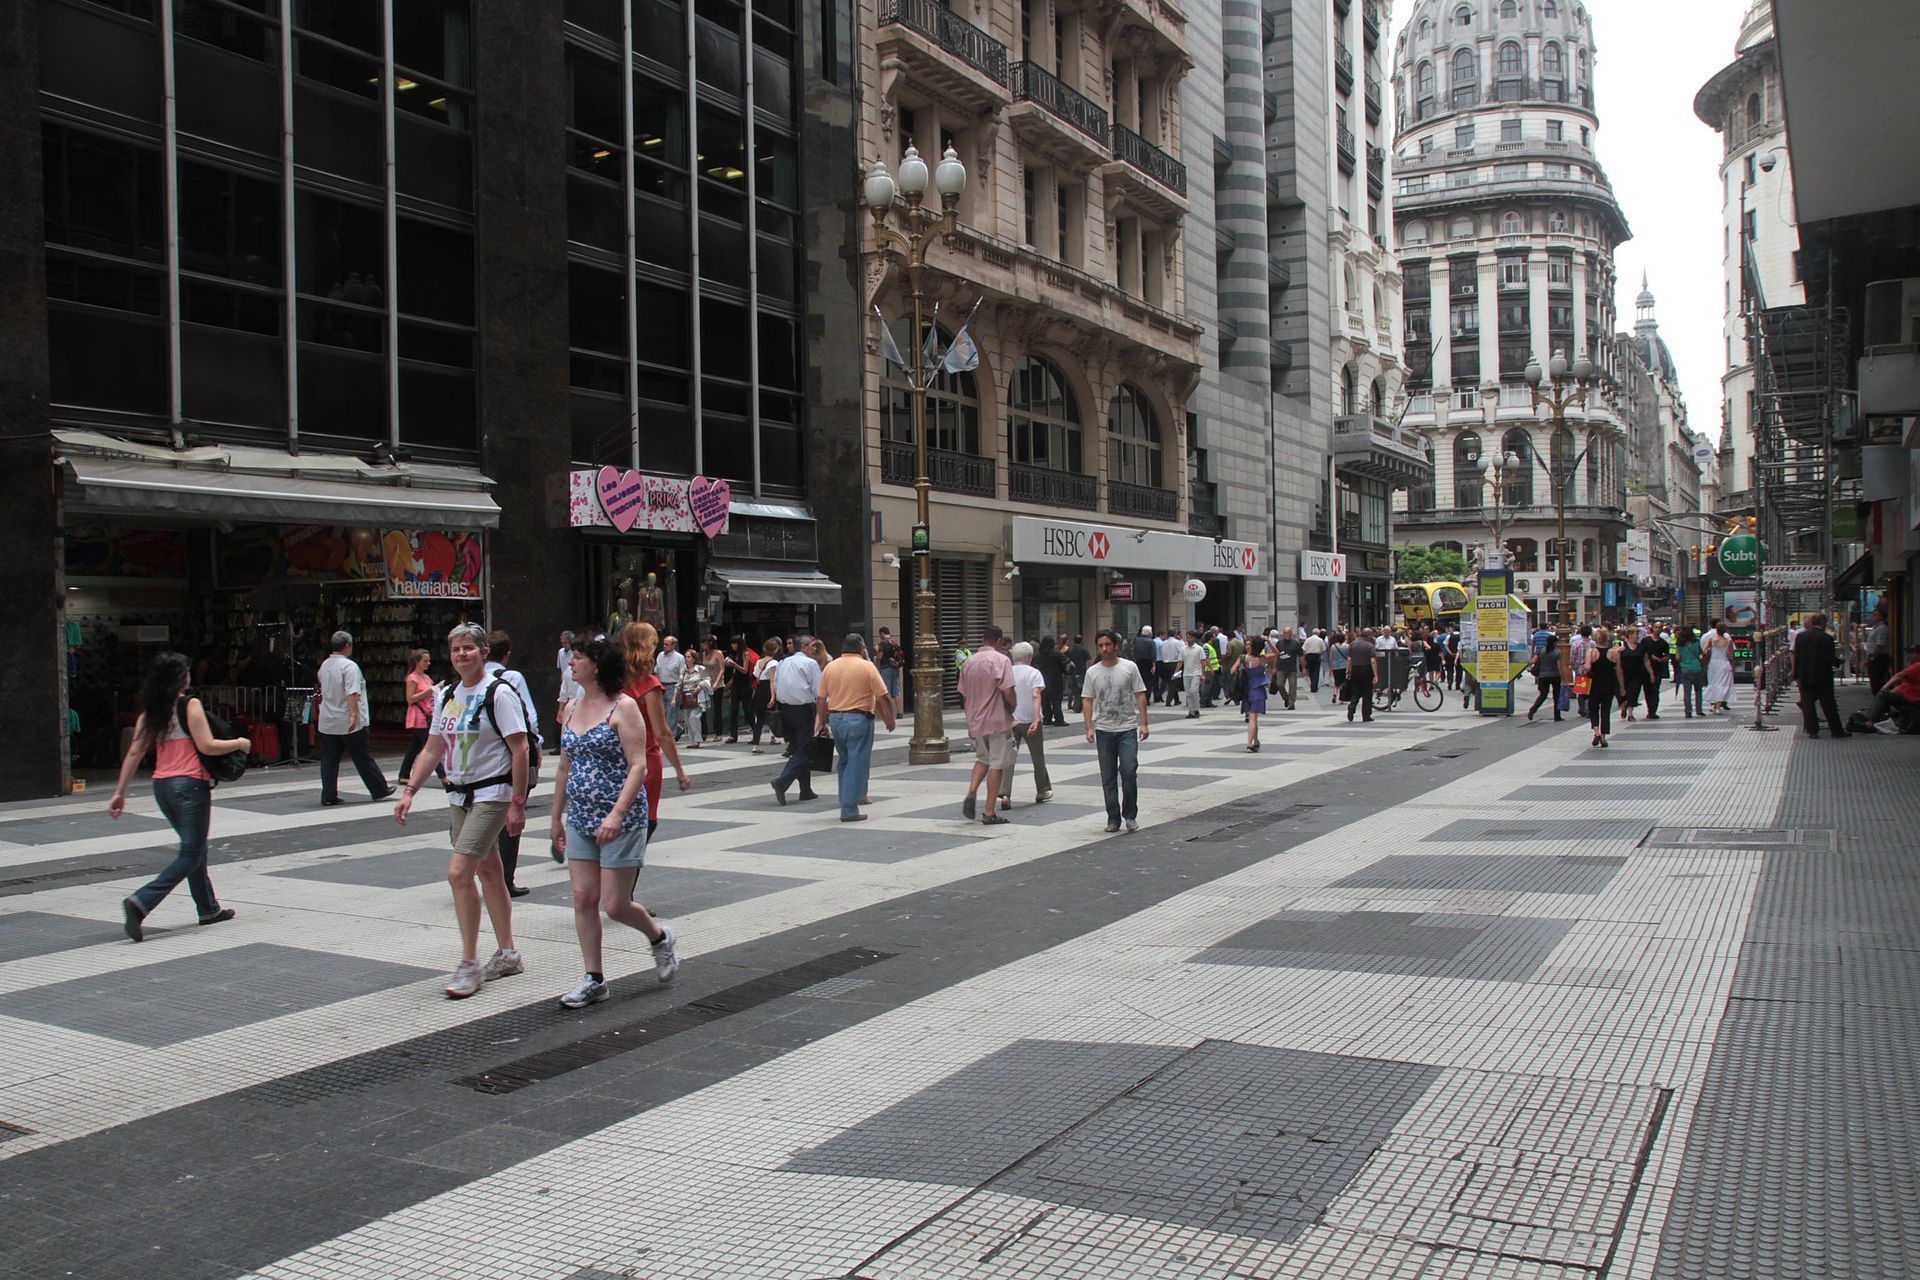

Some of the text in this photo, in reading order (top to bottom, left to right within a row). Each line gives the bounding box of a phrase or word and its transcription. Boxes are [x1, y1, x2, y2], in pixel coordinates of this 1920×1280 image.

[602, 481, 617, 493] LOS
[692, 485, 708, 497] PARA
[649, 490, 680, 508] PRIKA
[1043, 527, 1086, 558] HSBC
[1213, 545, 1240, 568] HSBC
[1310, 556, 1330, 577] HSBC
[394, 577, 469, 597] havaianas
[440, 717, 456, 731] 96
